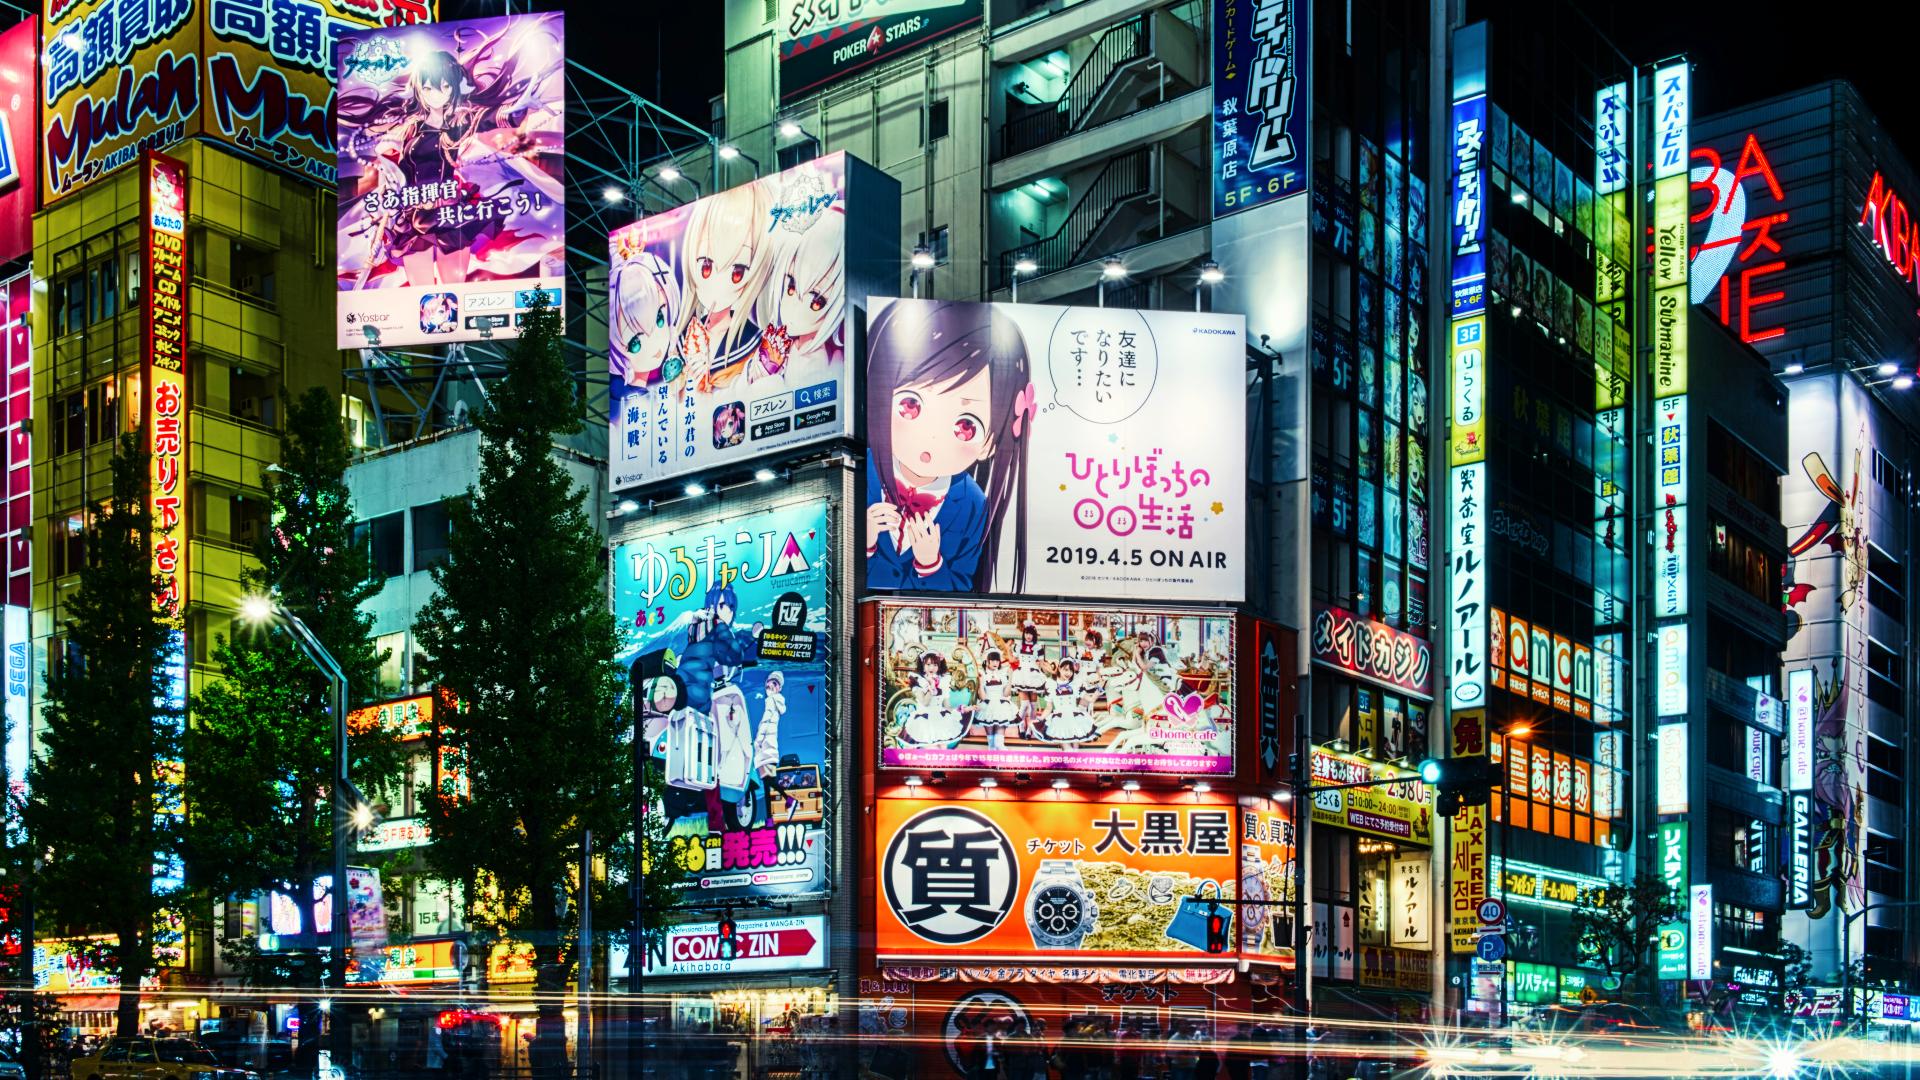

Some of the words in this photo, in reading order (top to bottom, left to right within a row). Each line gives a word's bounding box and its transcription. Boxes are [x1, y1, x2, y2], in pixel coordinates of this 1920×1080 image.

[833, 40, 867, 64] POKER
[885, 16, 921, 43] STARS
[47, 51, 198, 191] Mulan
[1222, 96, 1238, 180] 秋葉原店
[1662, 76, 1683, 167] スーパービル
[102, 143, 138, 173] AKIBA
[153, 213, 182, 230] あなたの
[154, 232, 182, 251] DVD
[153, 262, 182, 282] ゲーム
[1659, 224, 1676, 281] Yellow
[157, 278, 178, 296] CD
[153, 307, 182, 326] アニメ
[357, 312, 390, 322] Yostar
[1460, 326, 1478, 342] 3F
[1118, 330, 1136, 388] 友達に
[1659, 295, 1676, 388] Submarine
[1095, 329, 1112, 403] なりたい
[1462, 353, 1474, 421] りらくる
[657, 385, 668, 464] 望んでいる
[684, 378, 696, 457] これが君の
[753, 400, 787, 416] アズレン
[1662, 399, 1680, 411] 5F
[622, 472, 643, 483] Yostar
[1065, 448, 1210, 499] ひとりぼっちの
[1046, 547, 1143, 567] 2019.4.5
[1150, 549, 1184, 567] ON
[1189, 551, 1227, 569] AIR
[9, 641, 26, 697] SEGA
[1315, 613, 1428, 686] メイドカジノ
[1664, 630, 1680, 711] amiami
[1454, 717, 1483, 755] 免
[1027, 837, 1085, 855] チケット
[1092, 809, 1231, 857] 大黒屋
[1792, 795, 1808, 905] GALLERIA
[897, 826, 1006, 930] 質
[1404, 876, 1418, 938] ルノアール
[1483, 905, 1498, 918] 40
[749, 933, 779, 957] ZIN
[1484, 942, 1493, 958] P
[673, 961, 732, 973] Akihabara
[1516, 972, 1556, 993] リバティー
